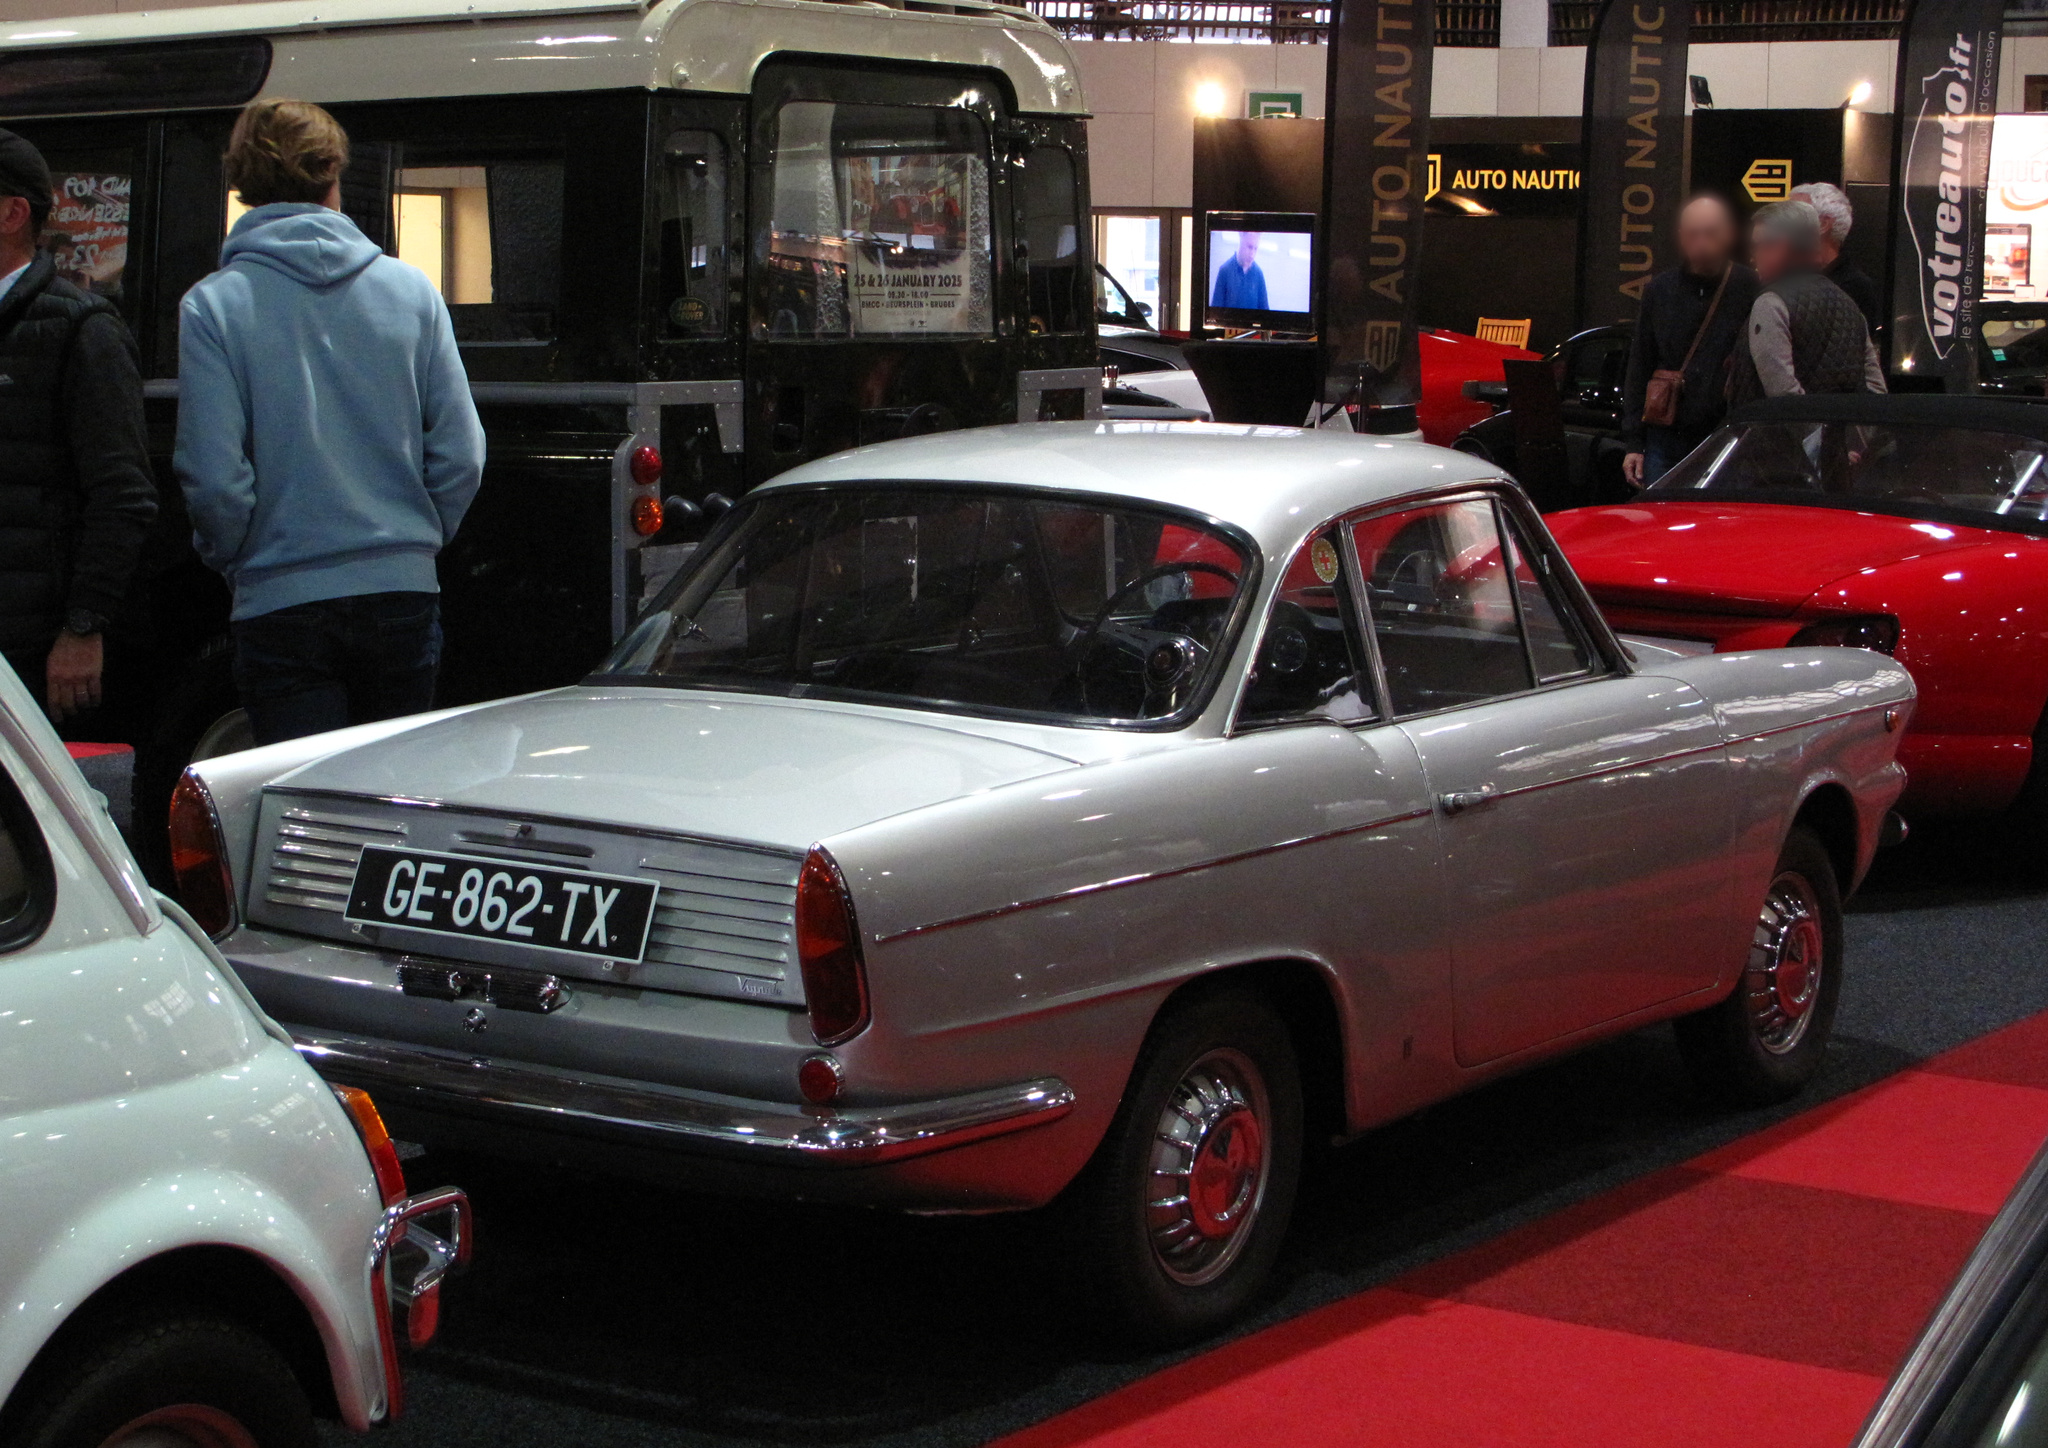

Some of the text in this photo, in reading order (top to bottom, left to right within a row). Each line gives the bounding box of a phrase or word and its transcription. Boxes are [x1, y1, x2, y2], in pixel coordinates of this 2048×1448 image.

[1979, 31, 1996, 112] d'occasion
[1618, 4, 1666, 300] AUTO NAUTIC
[1452, 169, 1507, 189] AUTO
[1988, 160, 2048, 190] youc
[1369, 165, 1411, 304] AUTO
[854, 274, 866, 287] 25
[867, 274, 876, 287] &
[891, 274, 936, 287] JANUARY
[938, 274, 962, 287] 2025
[1962, 276, 1972, 295] de
[930, 300, 955, 308] BRUGES
[1960, 300, 1972, 322] site
[1960, 326, 1972, 339] le
[382, 859, 621, 948] GE-862-TX
